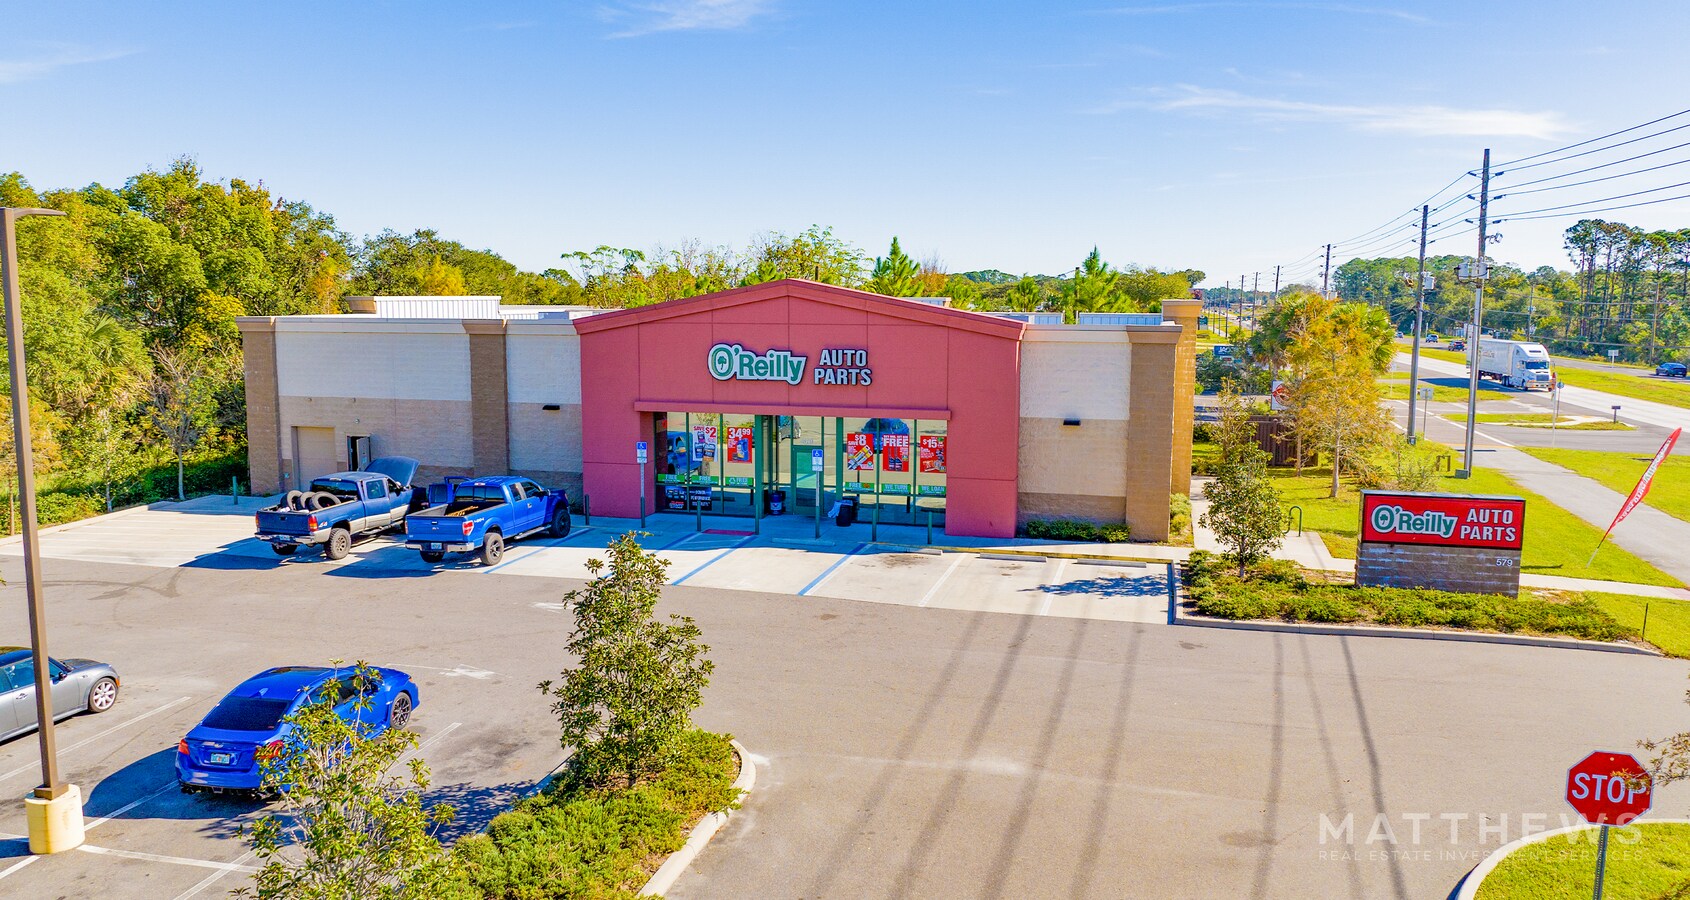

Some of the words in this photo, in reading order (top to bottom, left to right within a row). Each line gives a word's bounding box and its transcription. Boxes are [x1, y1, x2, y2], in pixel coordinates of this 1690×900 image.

[709, 344, 805, 384] O'Reilly
[819, 349, 868, 367] AUTO
[814, 368, 873, 386] PARTS
[705, 426, 717, 438] $2
[855, 434, 867, 446] $8
[883, 438, 909, 447] FREE
[922, 438, 938, 449] $15
[1373, 505, 1456, 537] O'Reilly
[1466, 508, 1514, 524] AUTO
[1460, 525, 1516, 542] PARTS
[1496, 558, 1513, 567] 579
[1571, 772, 1647, 805] STOP
